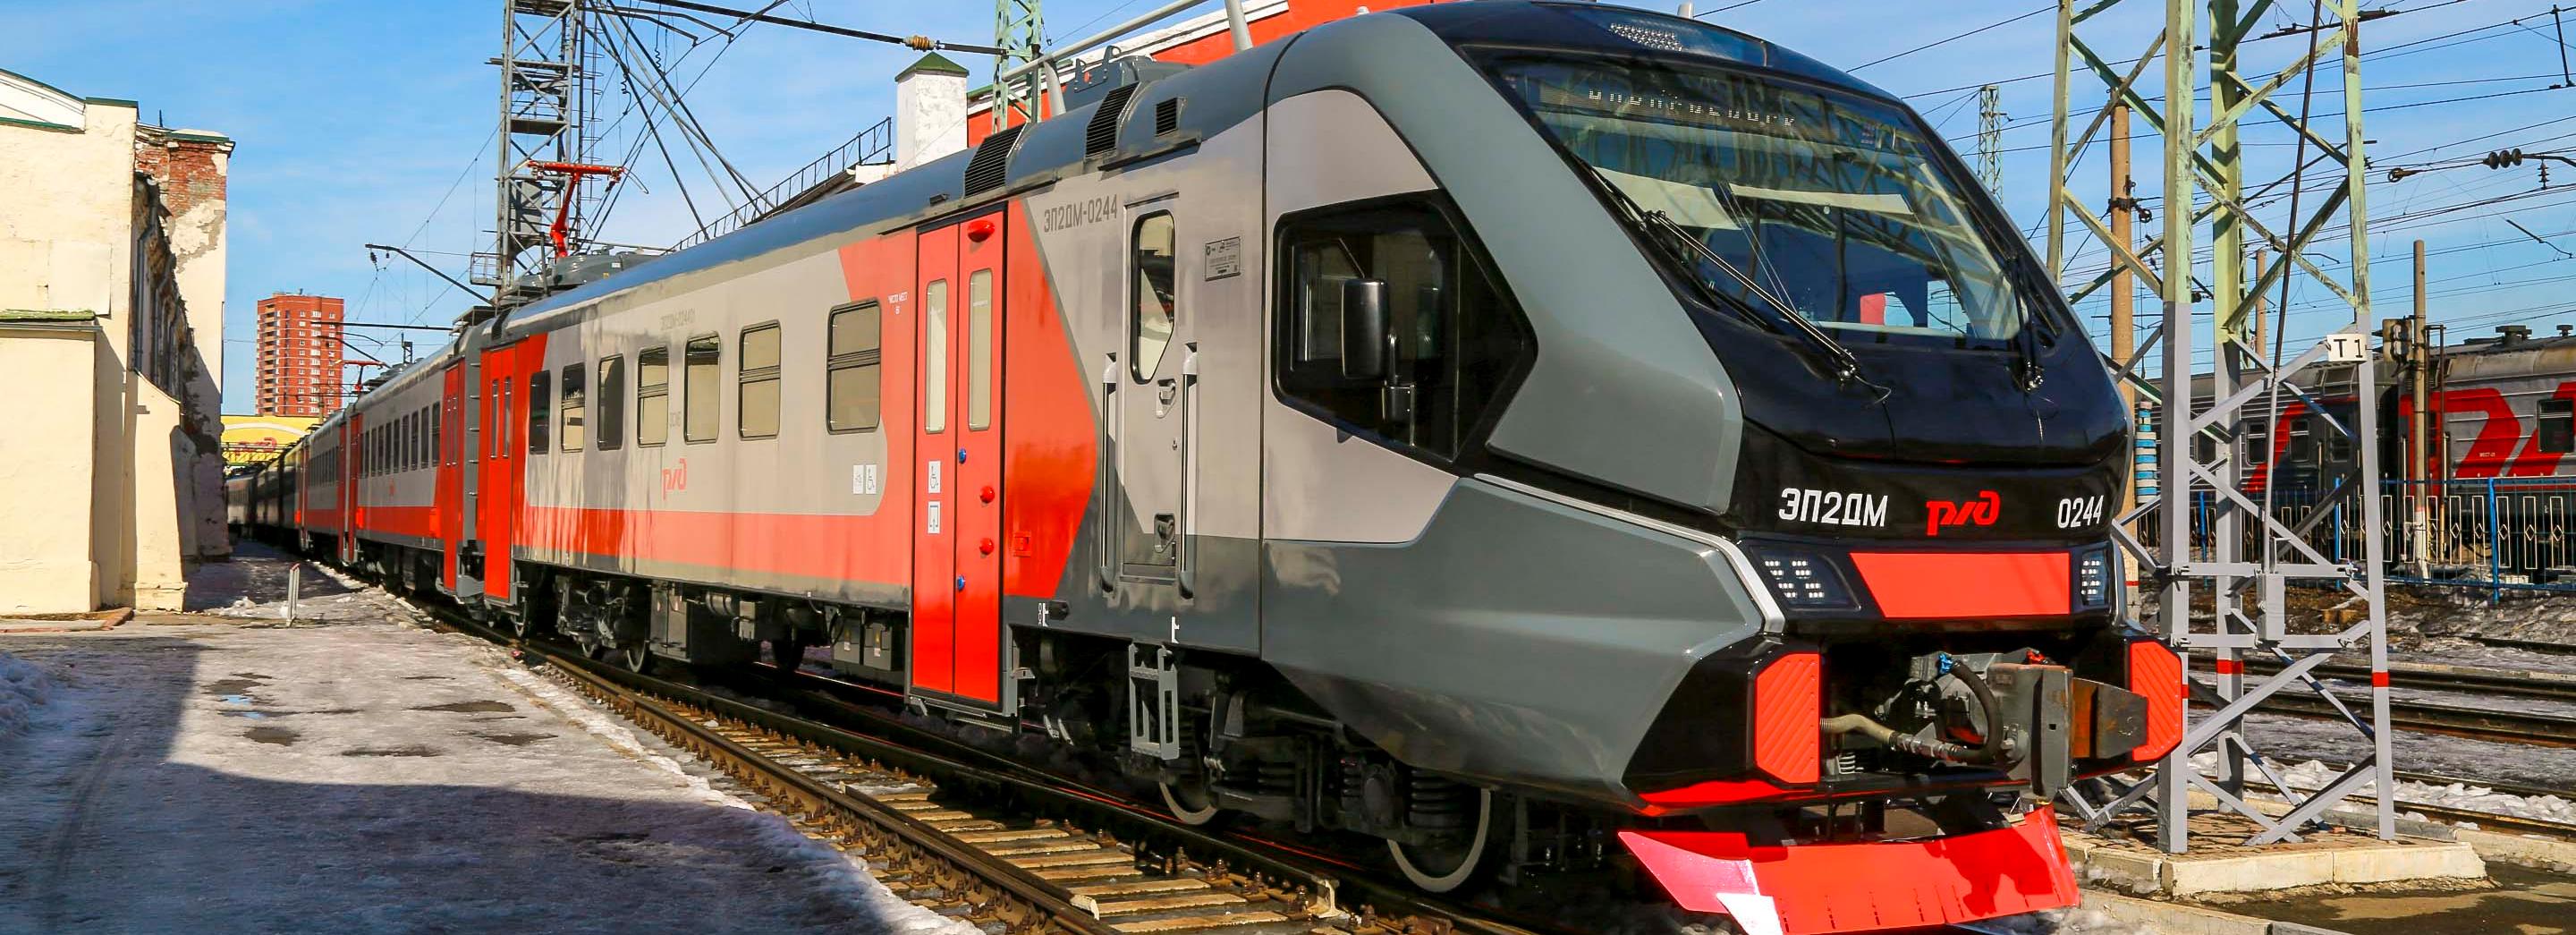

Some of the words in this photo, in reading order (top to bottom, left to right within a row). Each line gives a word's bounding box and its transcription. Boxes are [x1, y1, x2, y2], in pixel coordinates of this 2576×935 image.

[1044, 194, 1117, 233] ЭП2ДМ-0244
[1778, 488, 1888, 527] ЭП2ДМ
[2057, 495, 2104, 529] 0244
